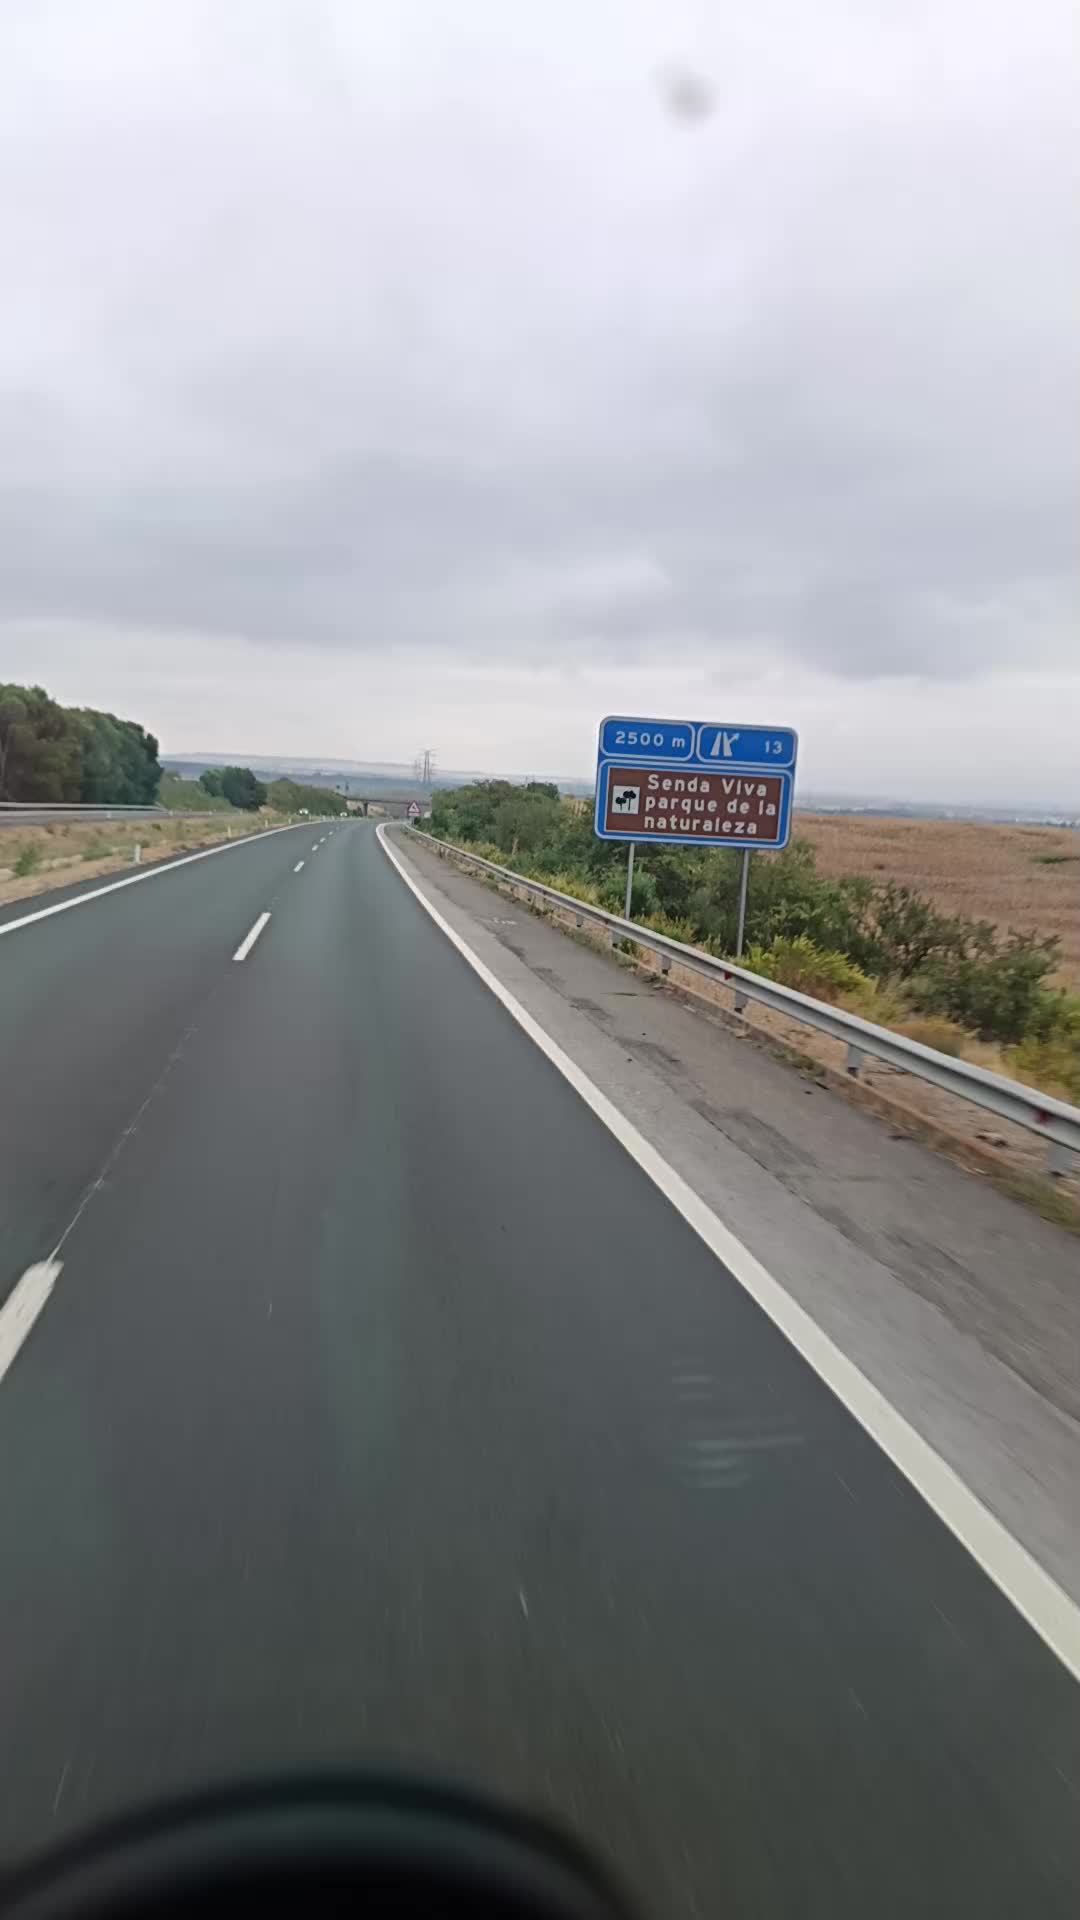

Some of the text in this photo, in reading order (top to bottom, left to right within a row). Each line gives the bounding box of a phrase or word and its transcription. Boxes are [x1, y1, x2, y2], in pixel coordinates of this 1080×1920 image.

[615, 731, 685, 748] 2500 m
[765, 740, 783, 754] 13
[647, 774, 767, 797] Senda Viva
[645, 796, 776, 816] parque de la
[644, 814, 758, 835] naturaleza
